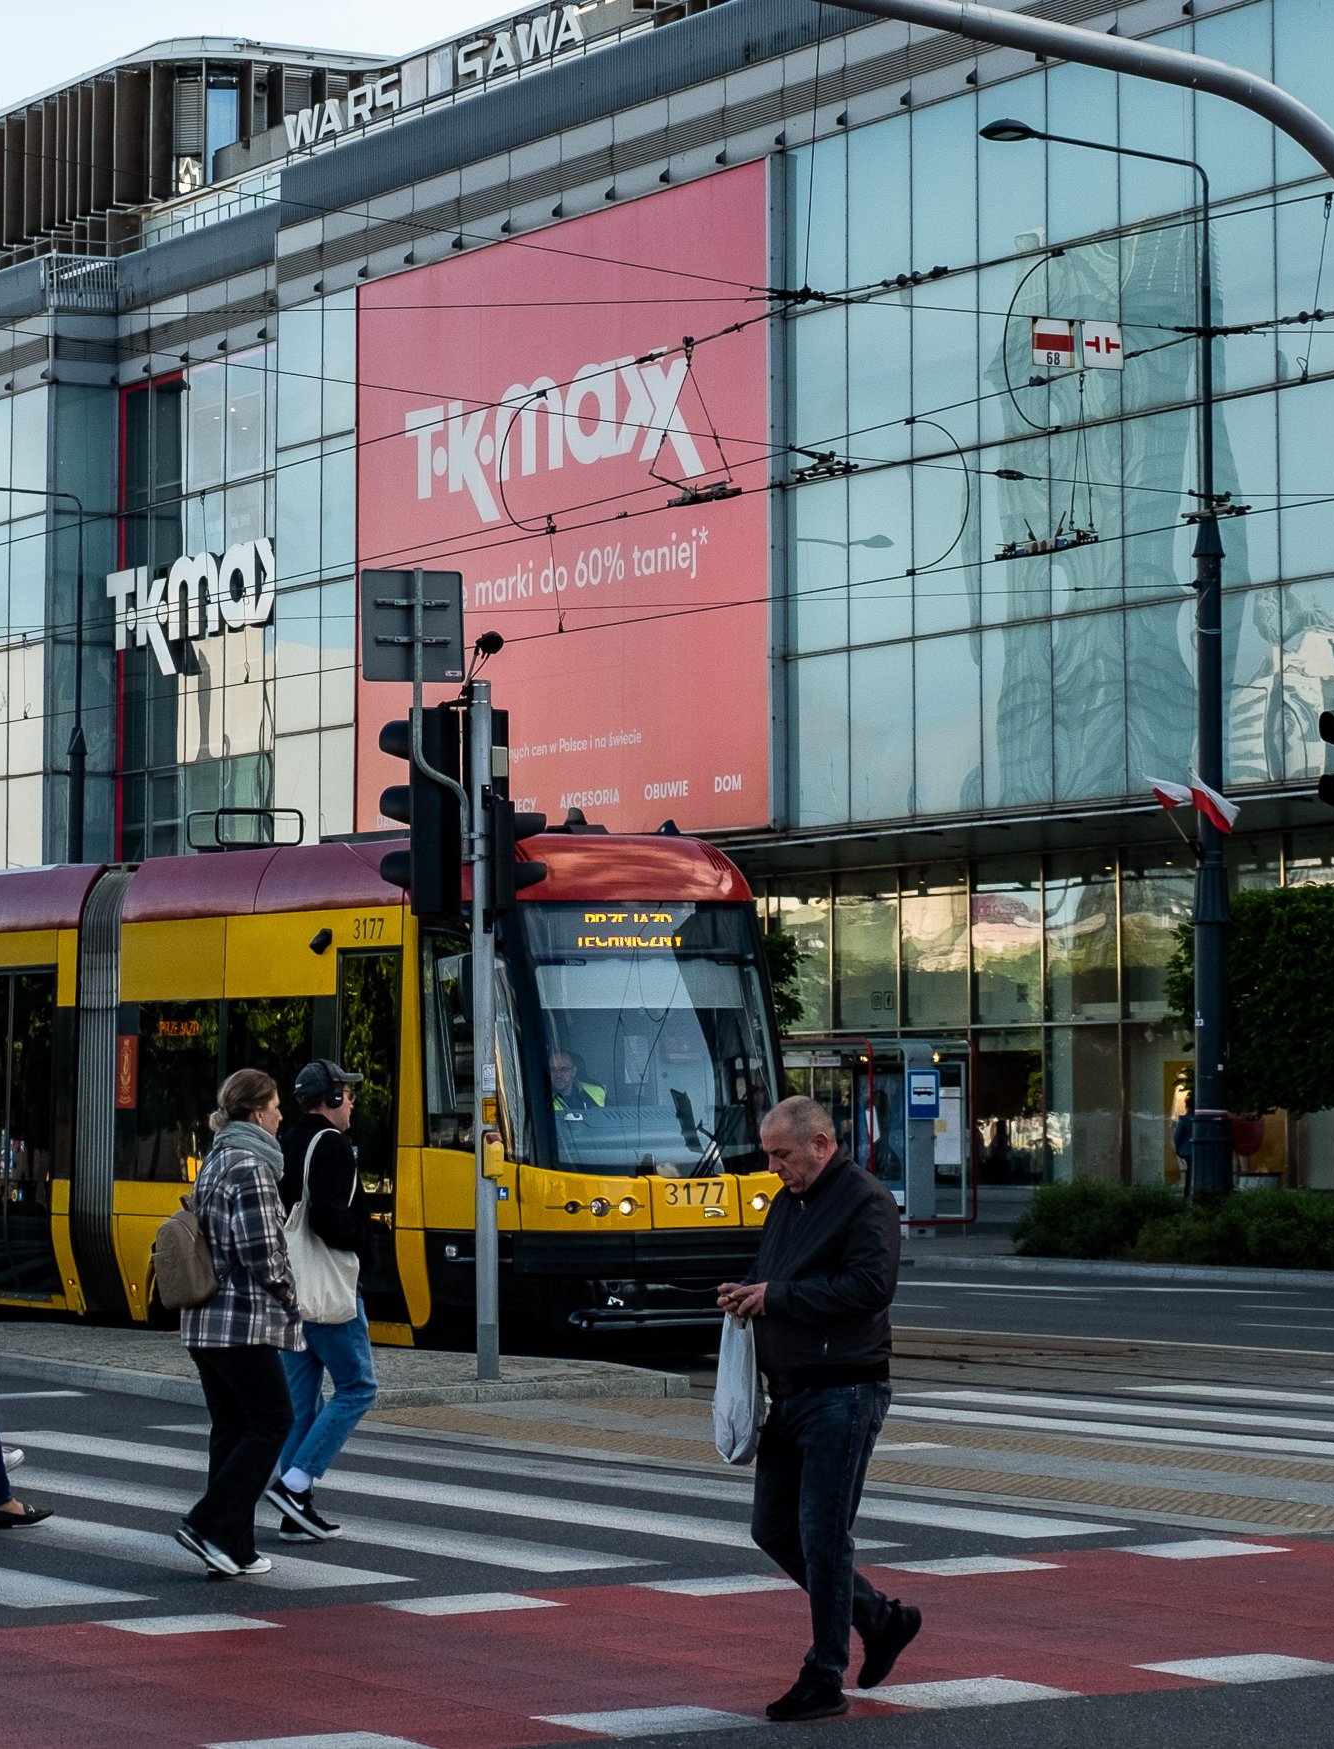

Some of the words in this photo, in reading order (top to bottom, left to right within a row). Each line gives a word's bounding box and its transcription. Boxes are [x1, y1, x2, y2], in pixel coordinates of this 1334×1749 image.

[284, 72, 400, 150] WARS
[458, 4, 585, 81] SAWA
[1046, 351, 1061, 366] 68
[474, 559, 534, 607] marki
[540, 557, 568, 595] do
[574, 542, 625, 589] 60%
[531, 745, 548, 759] cen
[549, 744, 557, 754] w
[559, 737, 588, 753] Polsce
[594, 738, 606, 749] na
[608, 728, 643, 748] świecie
[559, 788, 620, 809] AKCESORIA
[644, 779, 689, 800] OBUWIE
[714, 774, 742, 793] DOM
[353, 917, 385, 940] 3177
[665, 1182, 725, 1205] 3177
